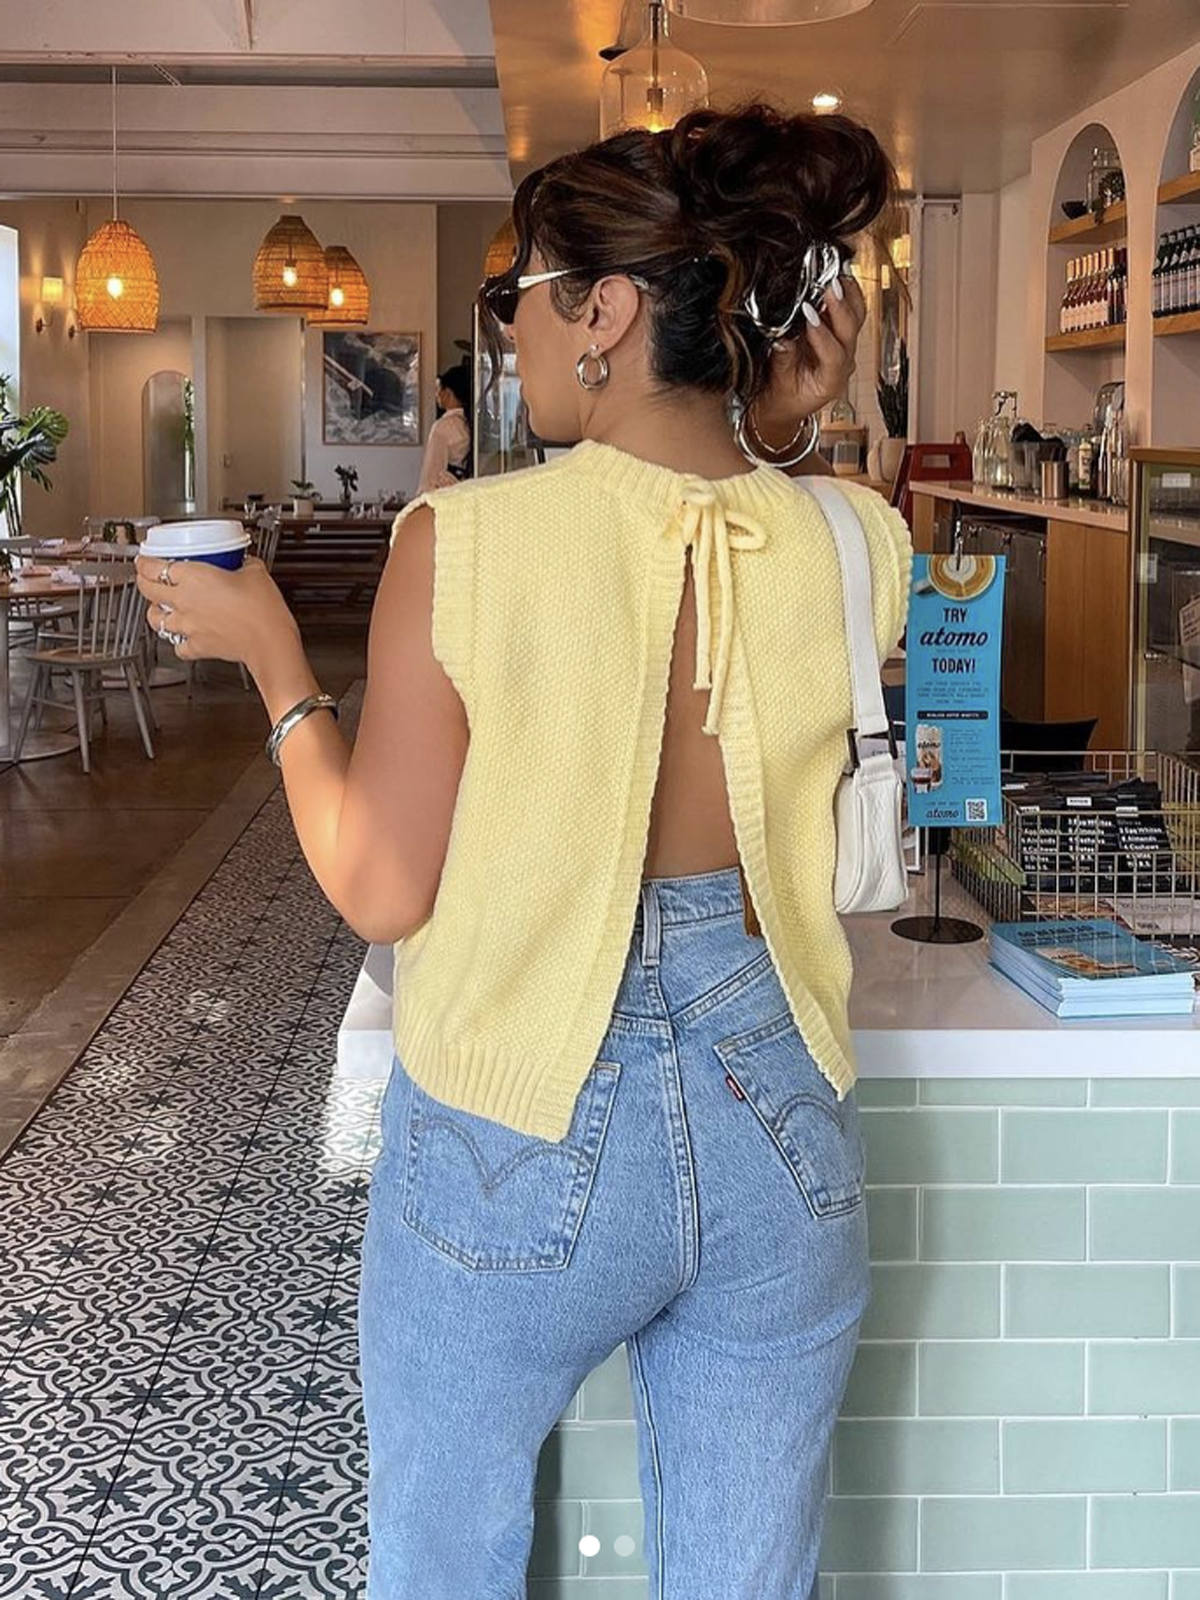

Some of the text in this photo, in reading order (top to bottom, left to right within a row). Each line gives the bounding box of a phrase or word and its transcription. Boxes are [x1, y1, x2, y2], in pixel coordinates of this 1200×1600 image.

[943, 607, 968, 623] TRY
[920, 626, 988, 647] atomo
[932, 657, 976, 673] TODAY!
[925, 808, 959, 819] atomo
